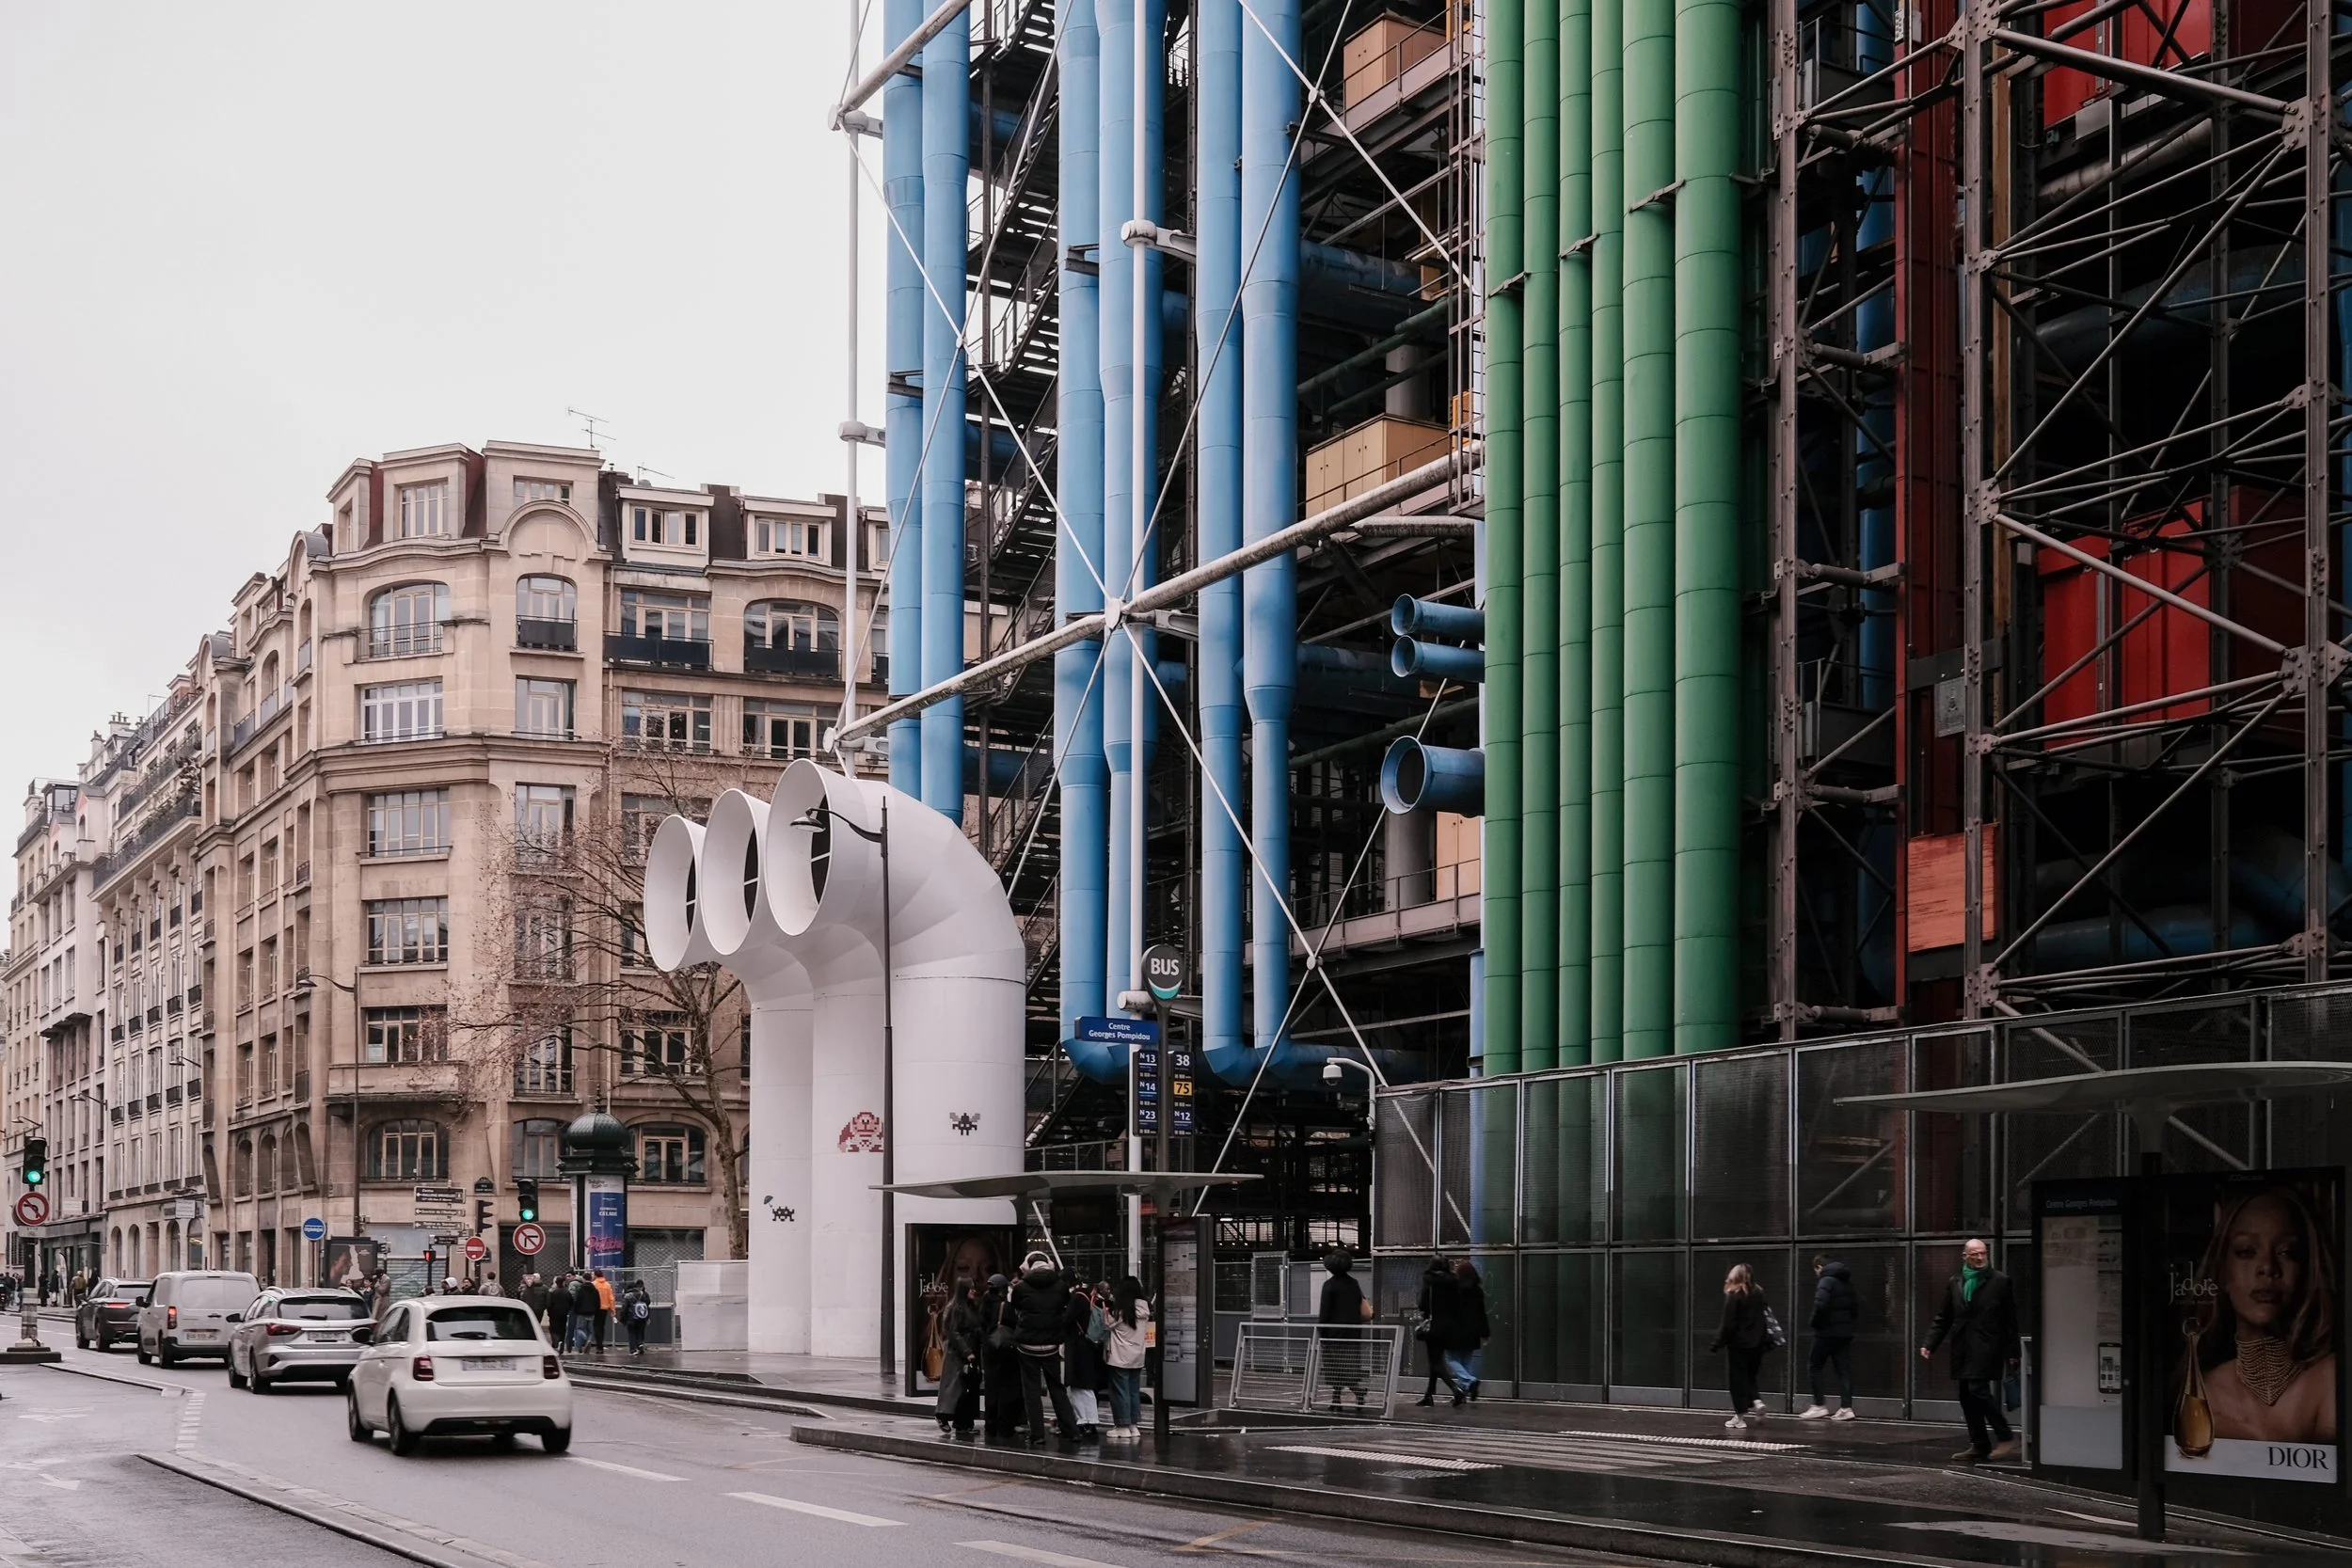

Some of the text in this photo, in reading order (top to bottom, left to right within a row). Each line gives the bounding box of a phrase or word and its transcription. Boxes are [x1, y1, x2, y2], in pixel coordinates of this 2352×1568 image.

[1151, 958, 1180, 976] BUS
[1108, 1022, 1131, 1031] Centre
[1089, 1029, 1151, 1040] Georges Pompidou
[1175, 1054, 1190, 1067] 38
[1176, 1083, 1190, 1094] 75
[2268, 1446, 2329, 1470] DIOR
